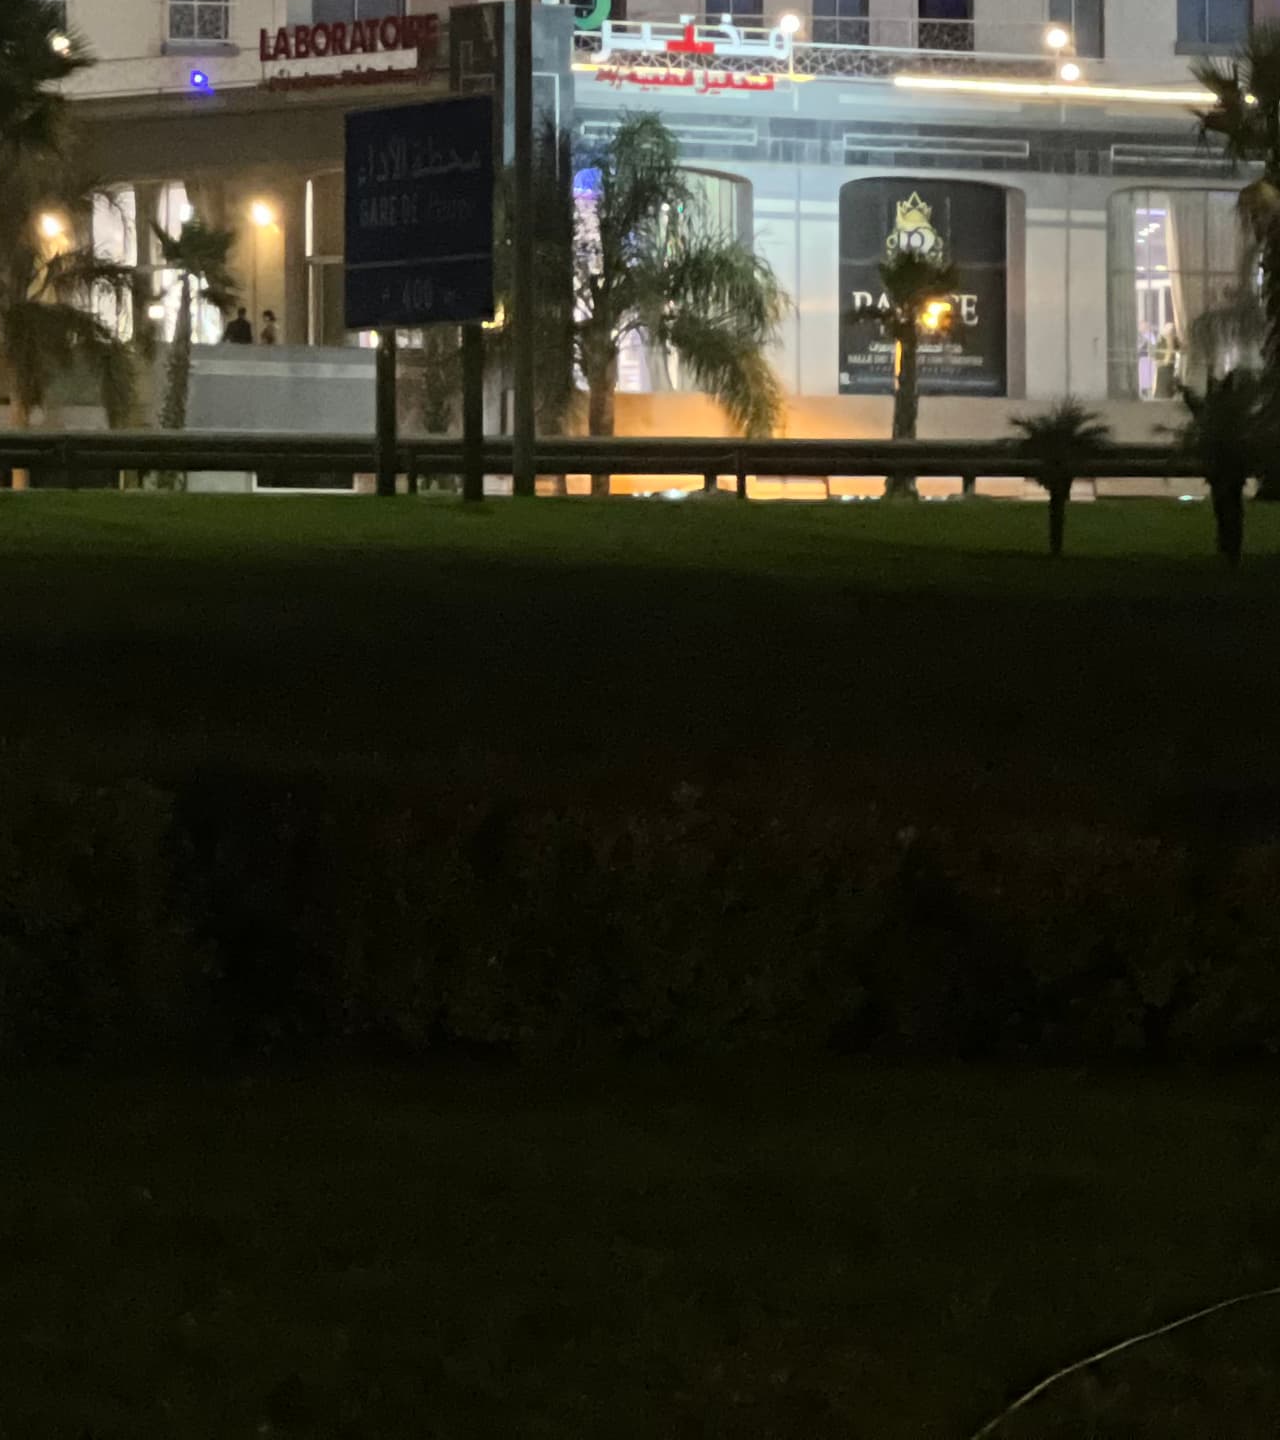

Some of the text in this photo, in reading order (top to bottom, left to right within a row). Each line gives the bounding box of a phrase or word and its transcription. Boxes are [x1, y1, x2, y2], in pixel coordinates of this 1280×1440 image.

[260, 14, 439, 62] LABORATOIRE
[590, 13, 791, 64] مختبر
[359, 195, 397, 227] GARE
